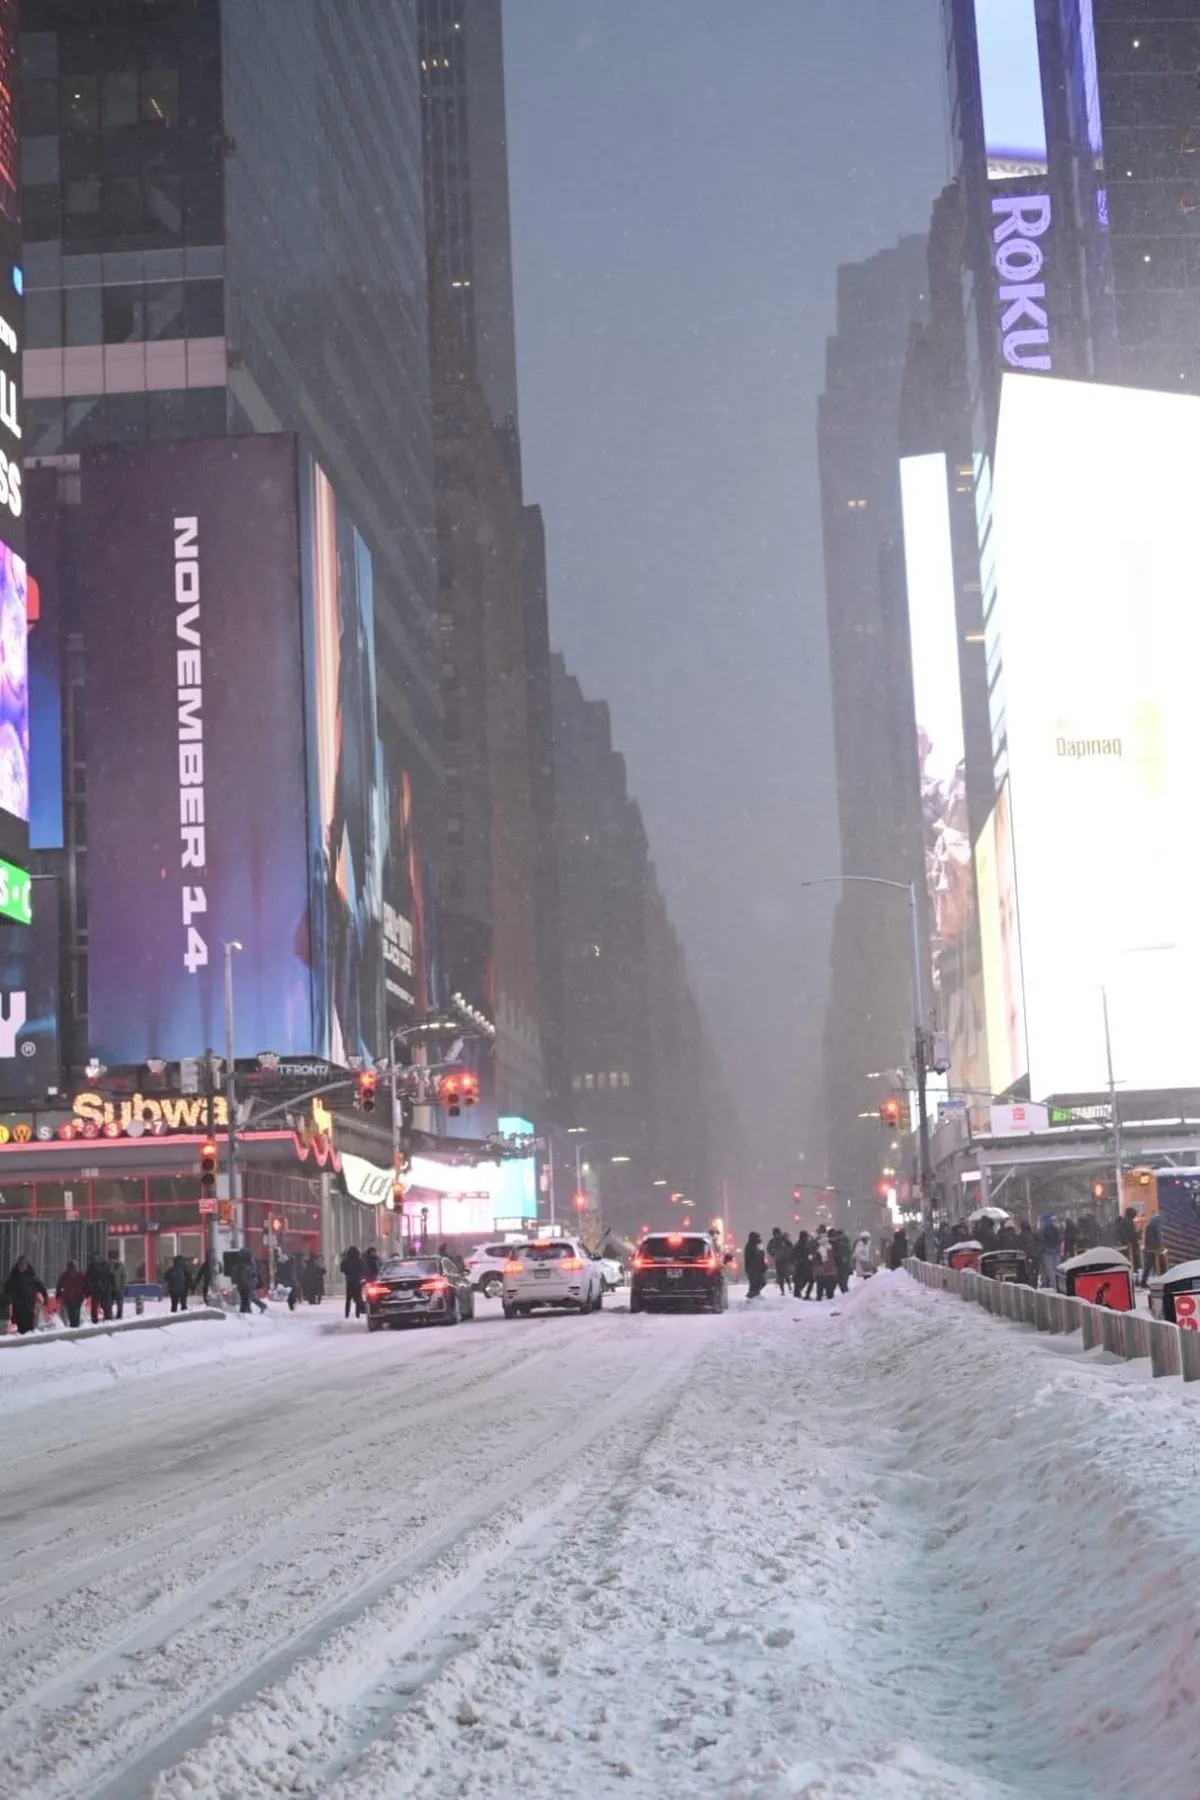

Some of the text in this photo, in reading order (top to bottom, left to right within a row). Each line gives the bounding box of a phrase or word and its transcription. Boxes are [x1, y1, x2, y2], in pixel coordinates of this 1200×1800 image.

[991, 195, 1051, 370] ROKU
[173, 516, 209, 974] NOVEMBER 14
[16, 1129, 30, 1142] W
[39, 1126, 50, 1138] S
[86, 1124, 96, 1137] 2
[107, 1123, 118, 1136] 3
[153, 1120, 163, 1133] 7
